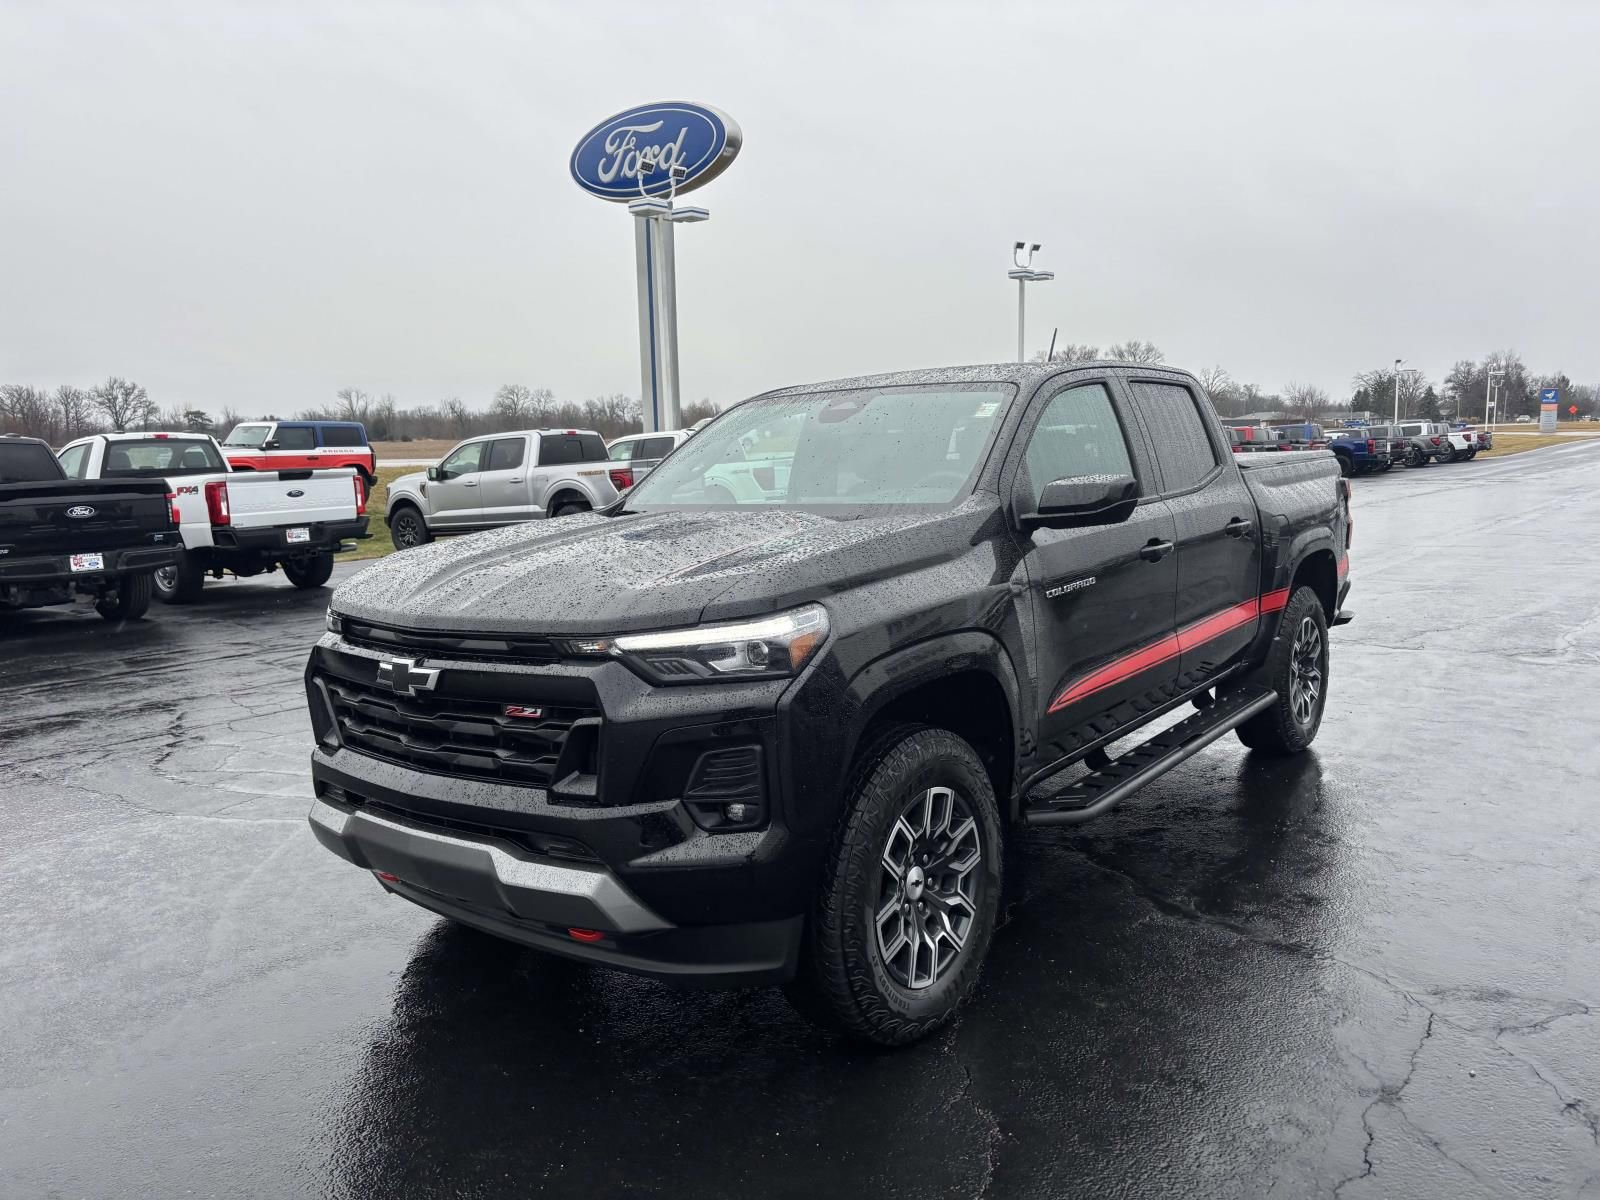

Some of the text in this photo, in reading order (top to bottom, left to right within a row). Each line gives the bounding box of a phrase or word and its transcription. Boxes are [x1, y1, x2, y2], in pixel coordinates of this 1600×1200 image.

[598, 120, 689, 183] Ford
[177, 486, 199, 496] FX4
[1046, 577, 1096, 598] COLORADO
[505, 705, 542, 717] Z71
[879, 974, 910, 1011] TERRITORY
